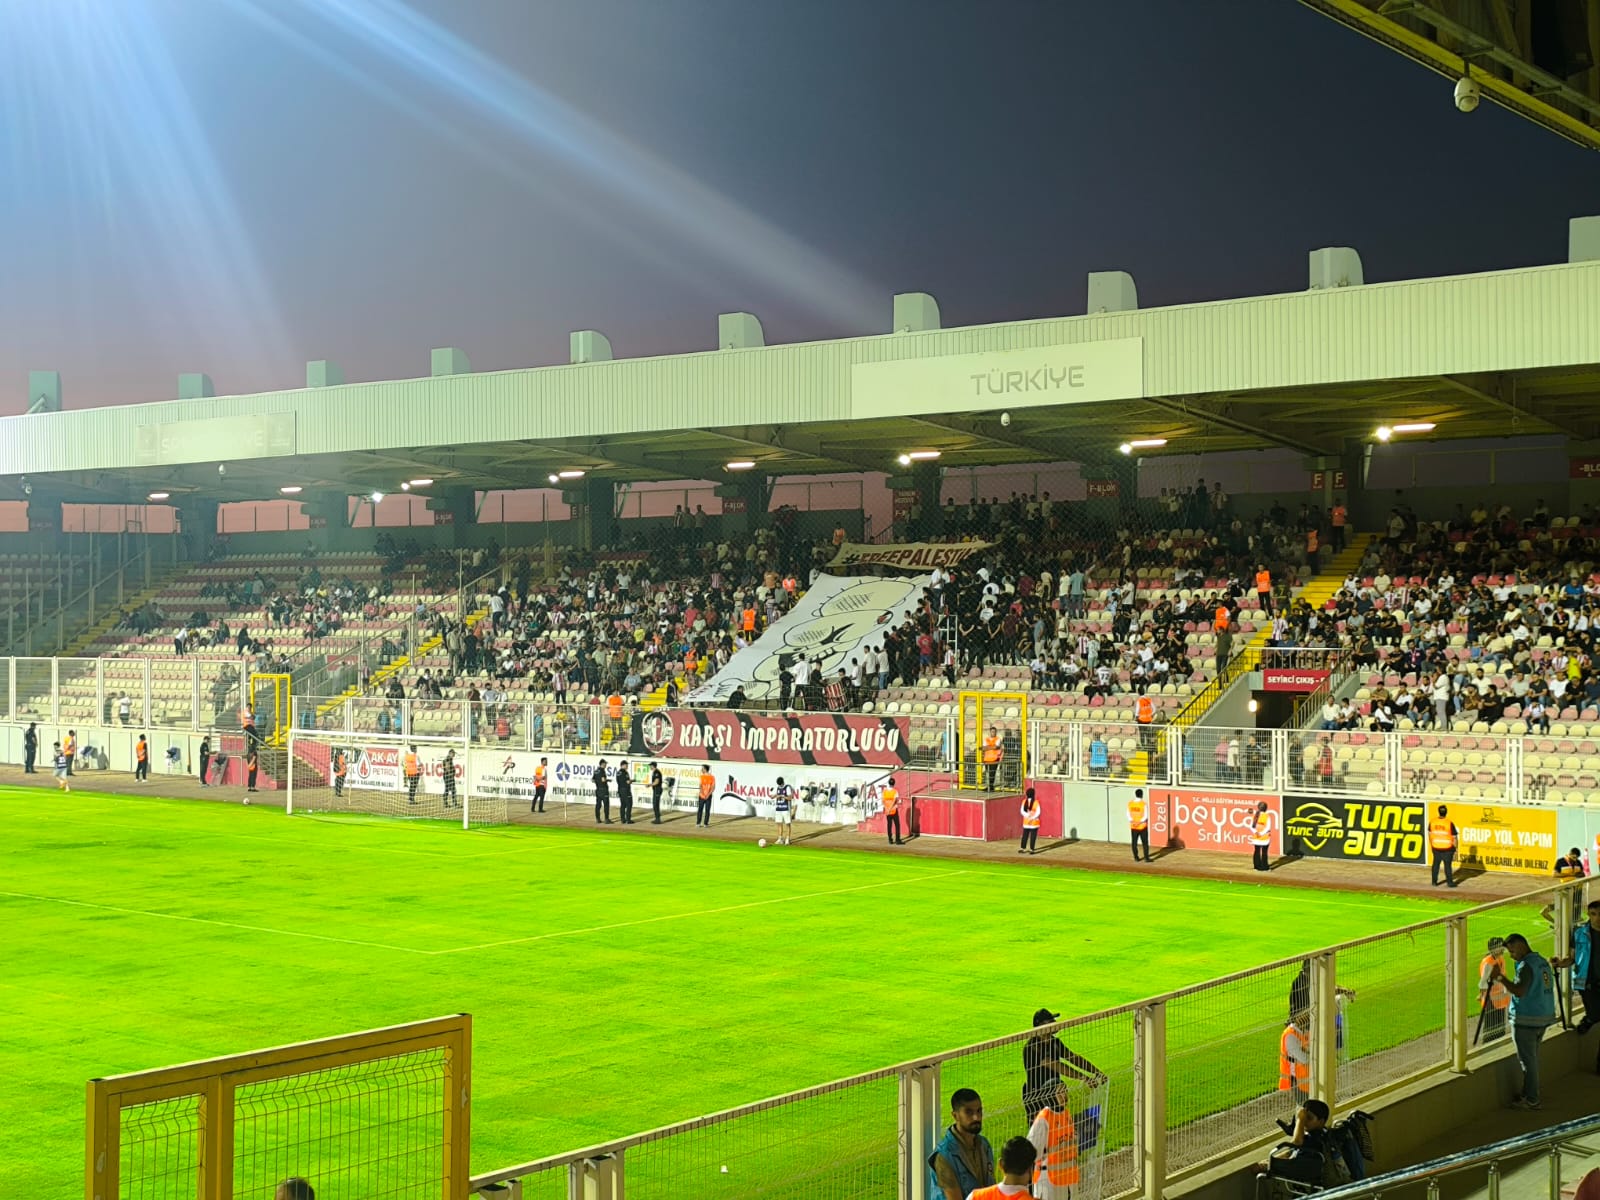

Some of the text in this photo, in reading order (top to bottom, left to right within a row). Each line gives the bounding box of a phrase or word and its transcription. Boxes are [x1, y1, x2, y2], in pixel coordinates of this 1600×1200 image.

[970, 363, 1085, 395] TÜRKİYE
[1314, 472, 1323, 485] F
[679, 722, 900, 752] KARŞI İMPARATORLUĞU
[1152, 801, 1167, 832] Özel
[1224, 830, 1254, 845] Kurs
[1316, 827, 1344, 839] AUTO
[1343, 830, 1423, 859] AUTO
[1462, 827, 1553, 848] GRUP YOL YAPIM
